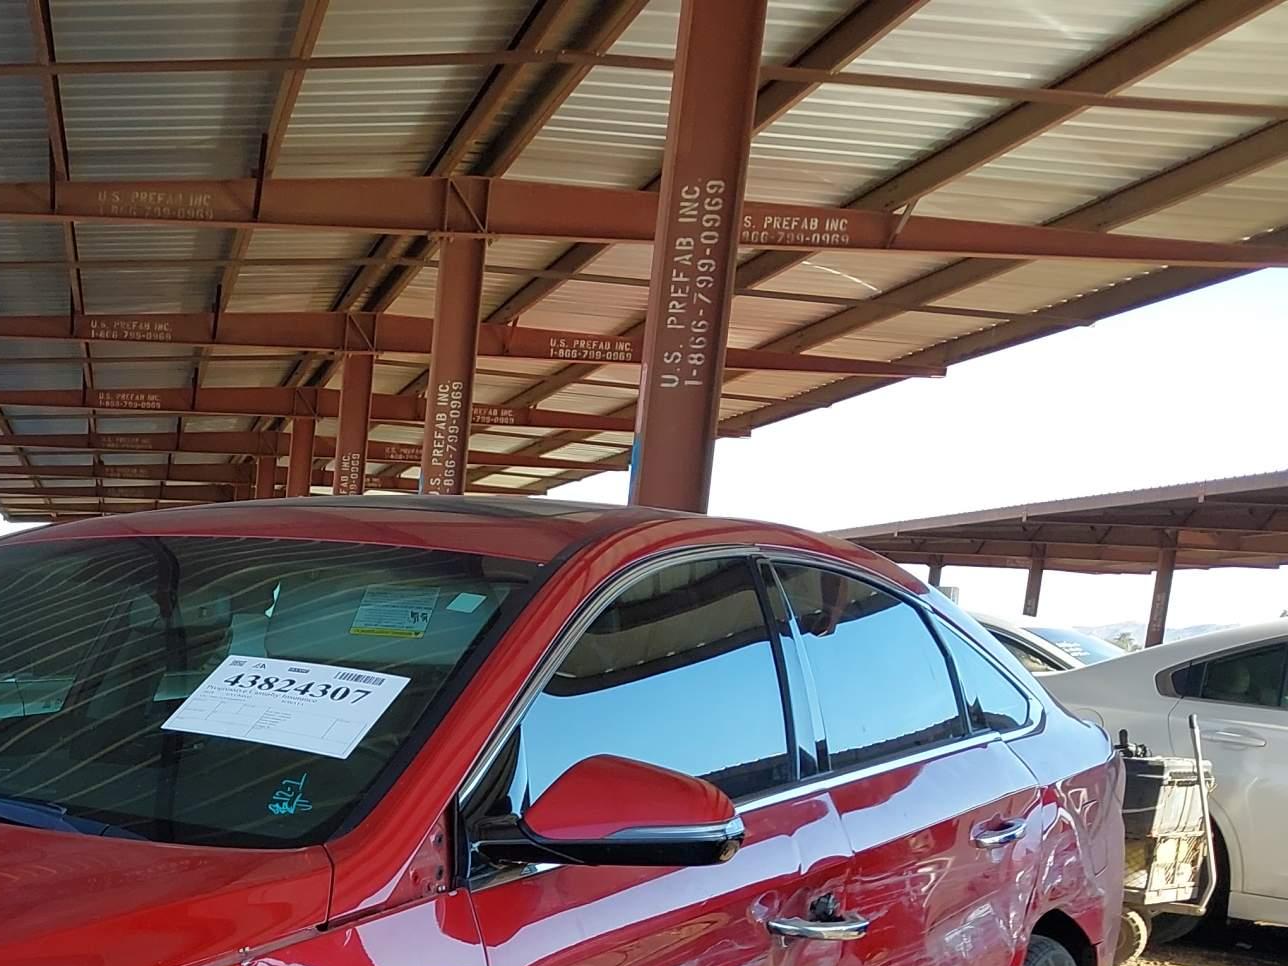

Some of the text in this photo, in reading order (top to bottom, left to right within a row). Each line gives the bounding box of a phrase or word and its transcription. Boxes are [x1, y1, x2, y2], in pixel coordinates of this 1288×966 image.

[763, 216, 819, 231] PREFAB
[667, 236, 694, 329] PREFAB
[684, 179, 726, 386] 1-866-799-0969
[573, 339, 611, 351] PREFAB
[432, 412, 448, 466] PREFAB
[443, 381, 464, 493] -866-799-0969
[224, 672, 372, 705] 43824307
